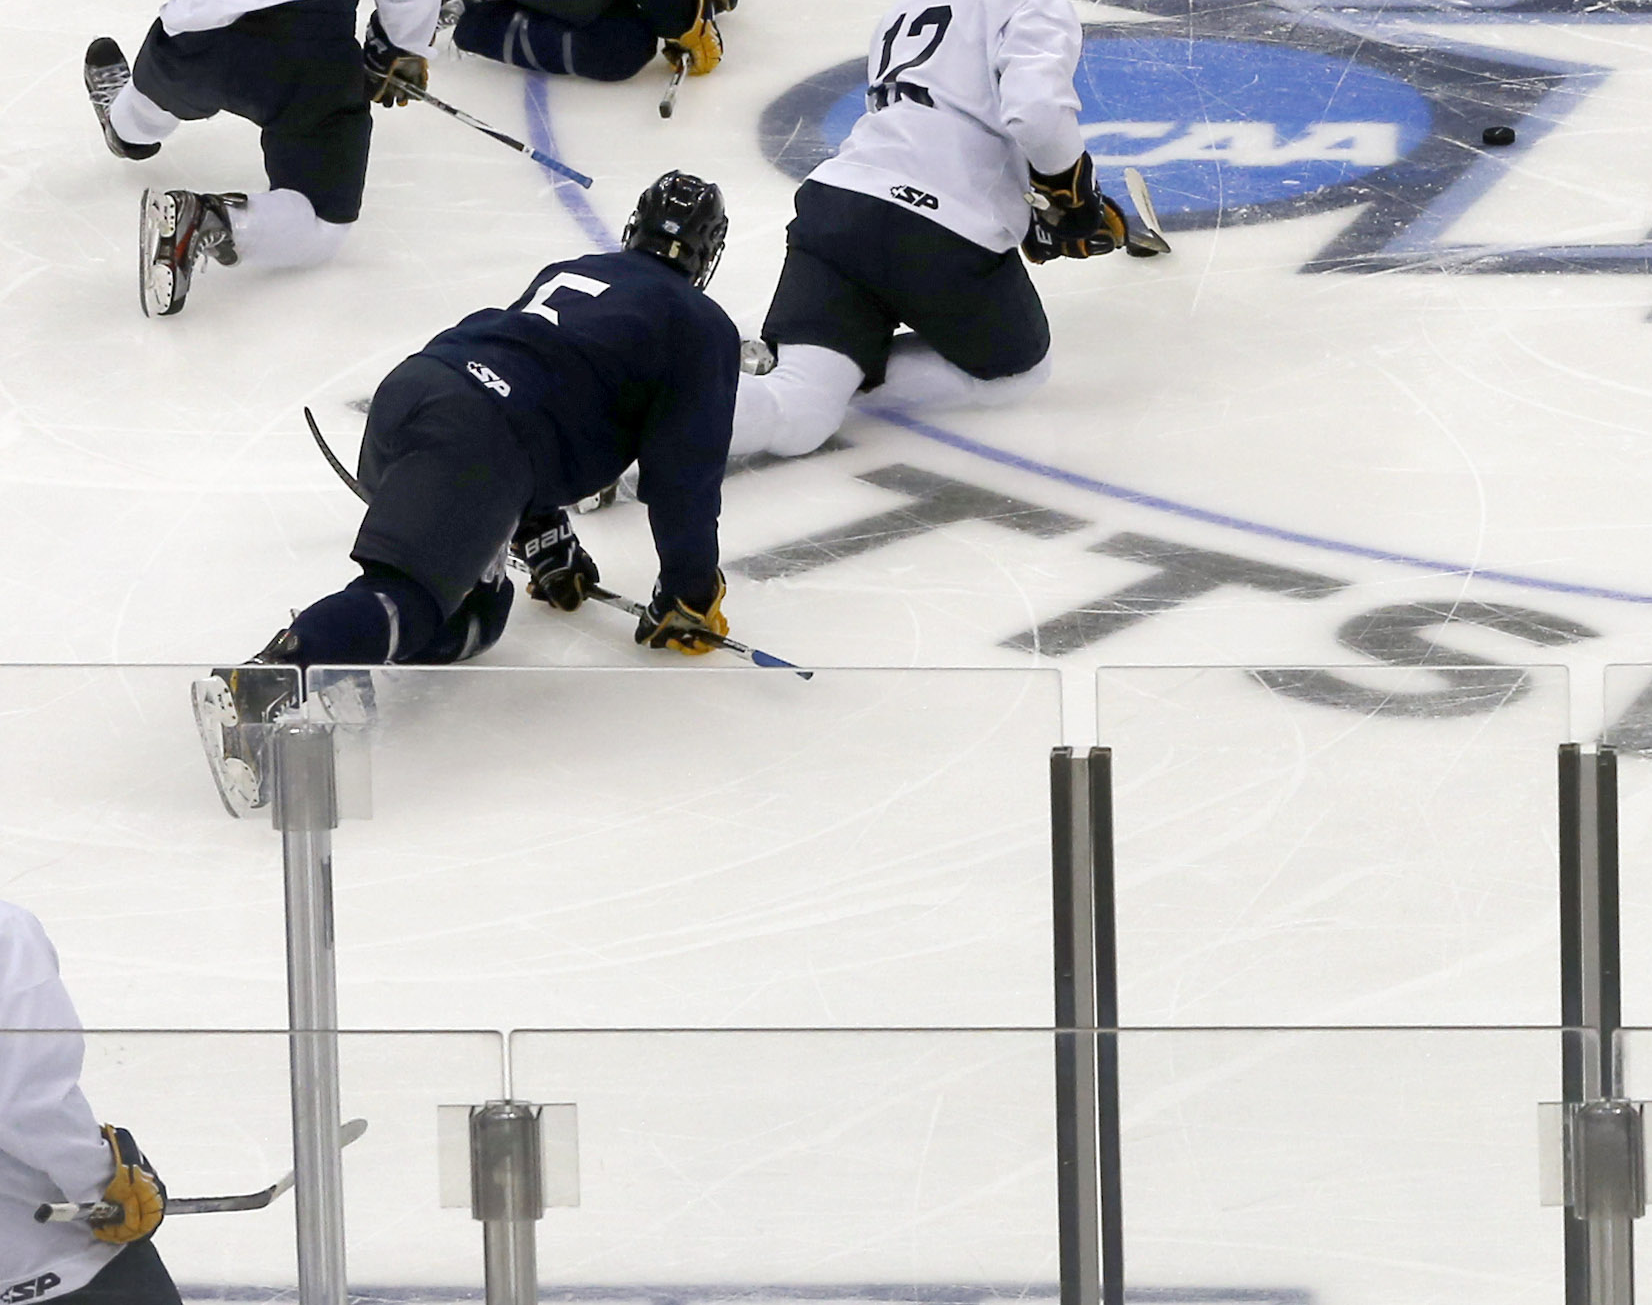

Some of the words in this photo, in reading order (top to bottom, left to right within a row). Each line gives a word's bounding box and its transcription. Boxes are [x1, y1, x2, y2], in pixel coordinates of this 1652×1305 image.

[866, 3, 953, 113] 12
[1080, 121, 1401, 168] CAA
[524, 520, 573, 558] BAU
